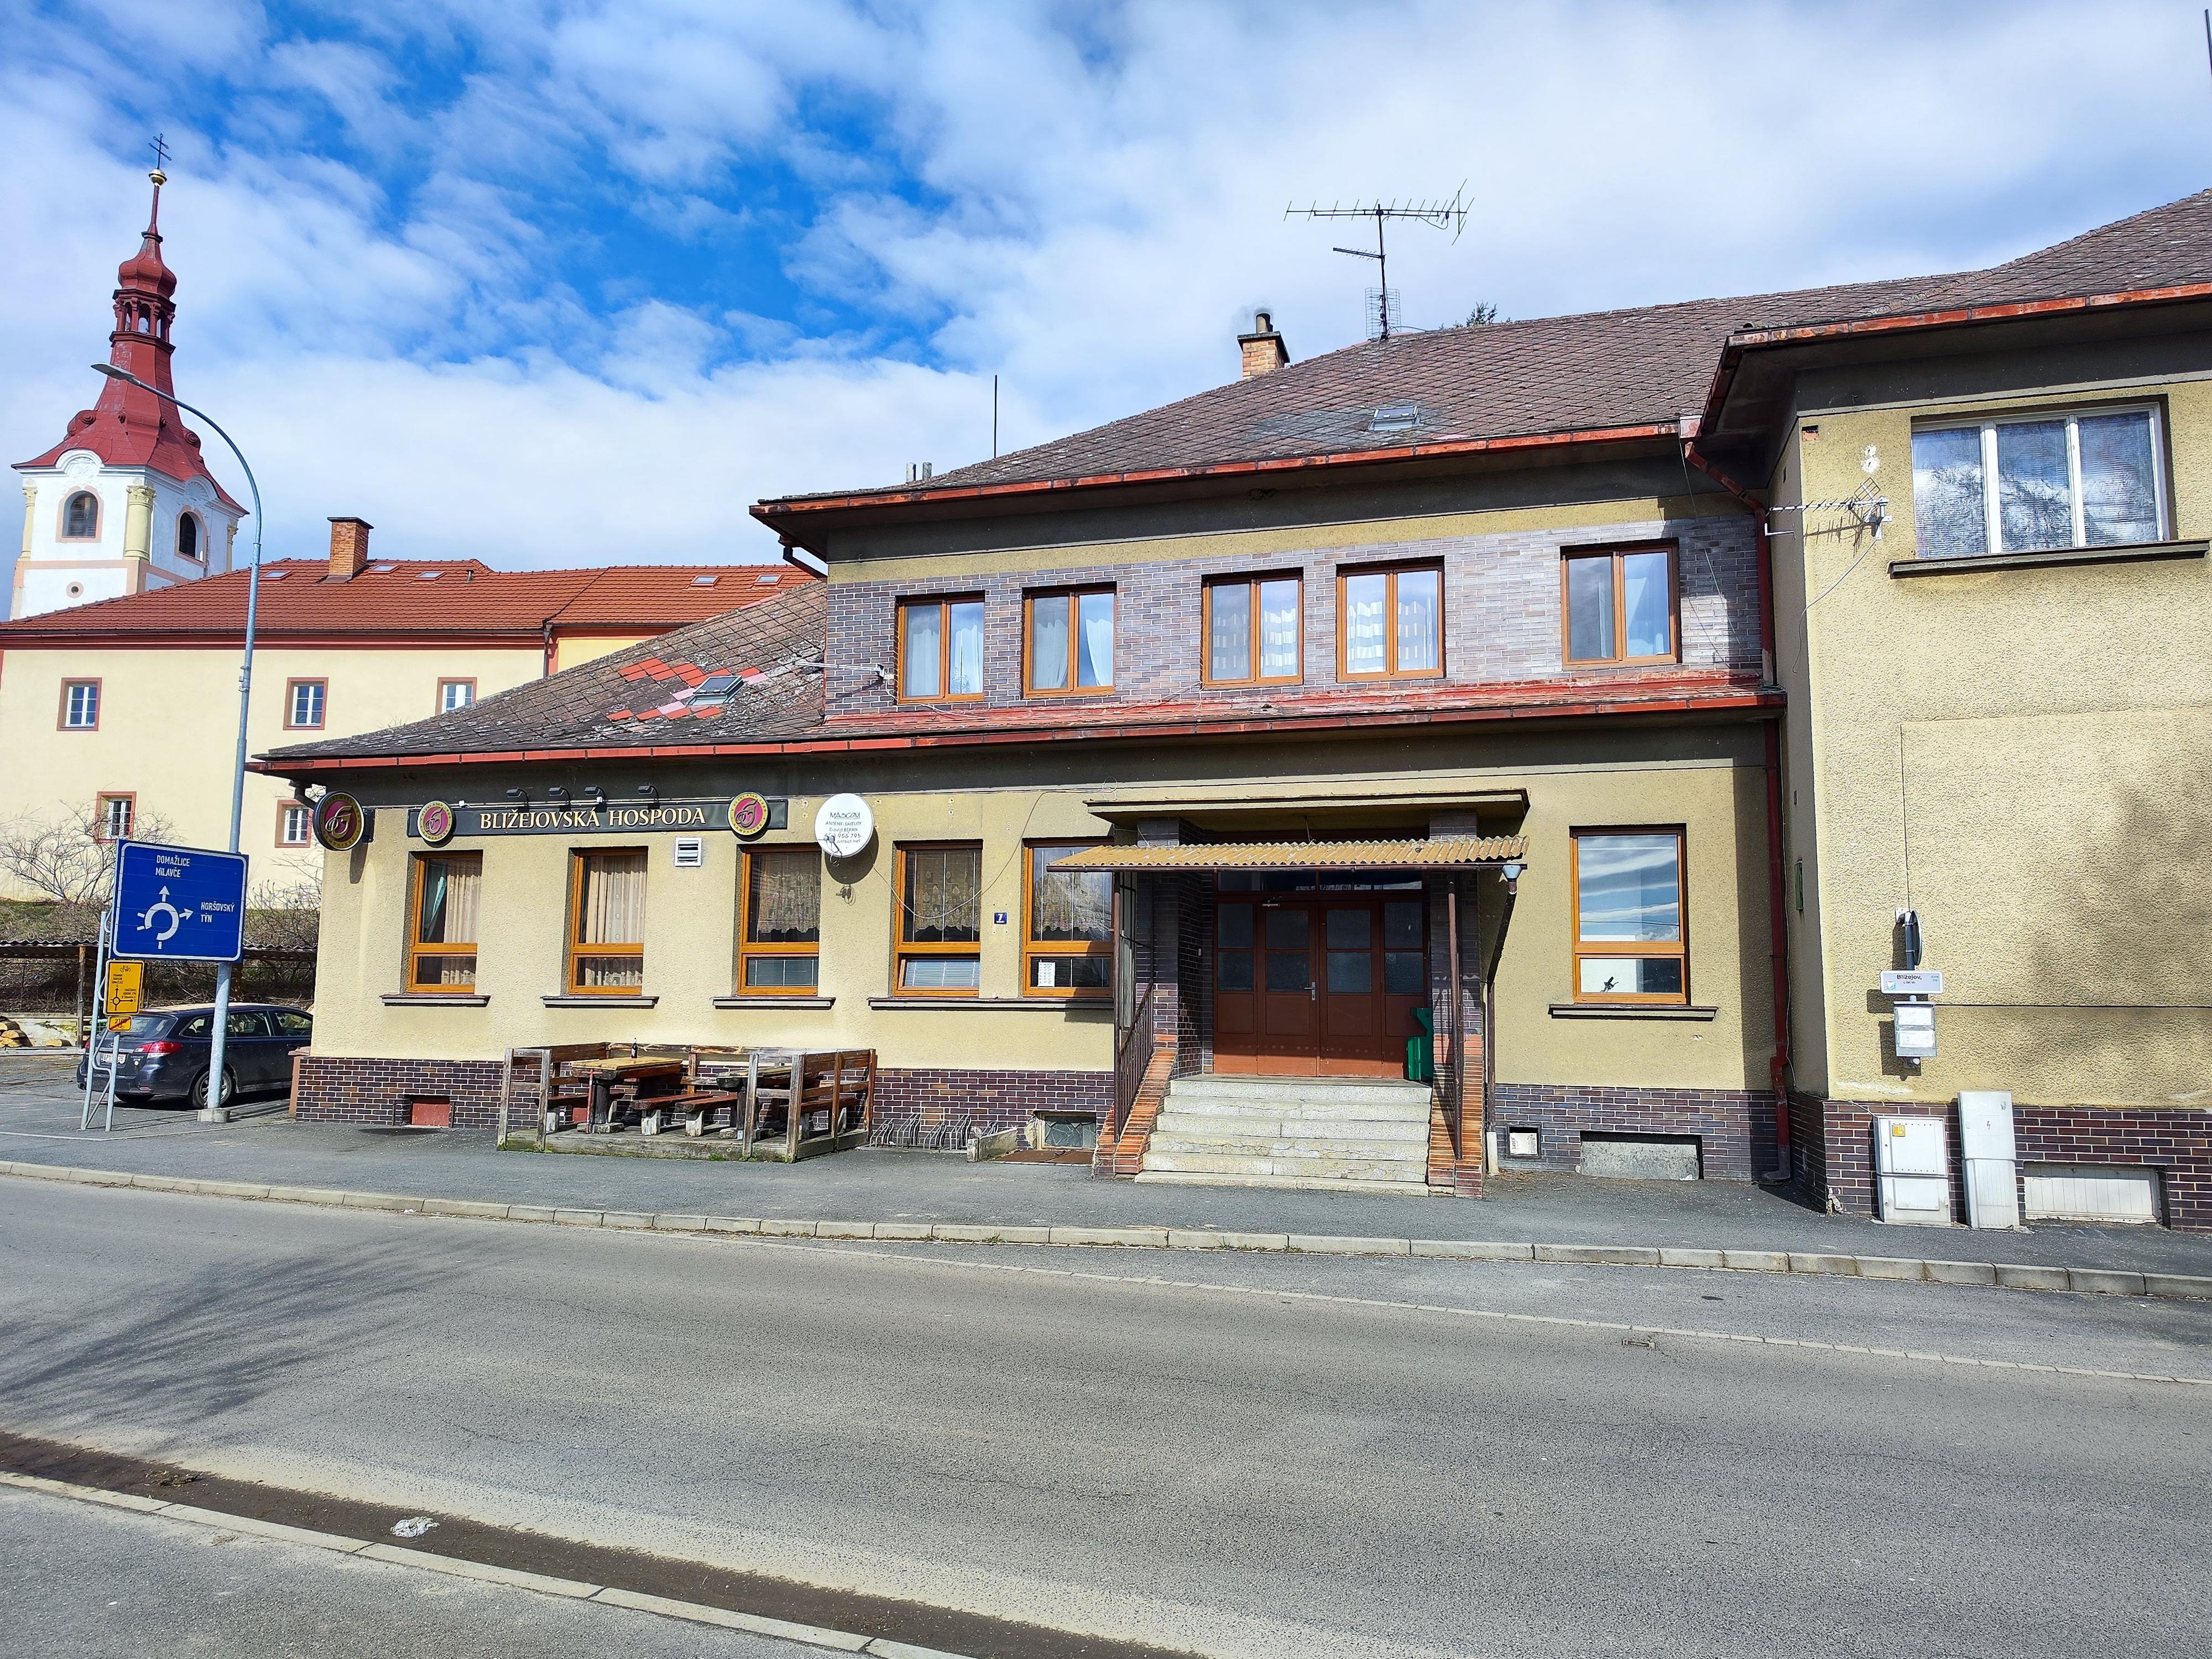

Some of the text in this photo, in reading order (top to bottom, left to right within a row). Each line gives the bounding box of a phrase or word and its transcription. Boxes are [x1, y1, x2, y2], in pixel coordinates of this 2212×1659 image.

[479, 807, 706, 829] BLIŽEJOVSKÁ HOSPODA
[156, 854, 190, 867] DOMAŽLICE
[155, 867, 181, 878] MILAVČE
[201, 901, 235, 912] HORŠOVSKÝ
[201, 912, 212, 923] TÝN
